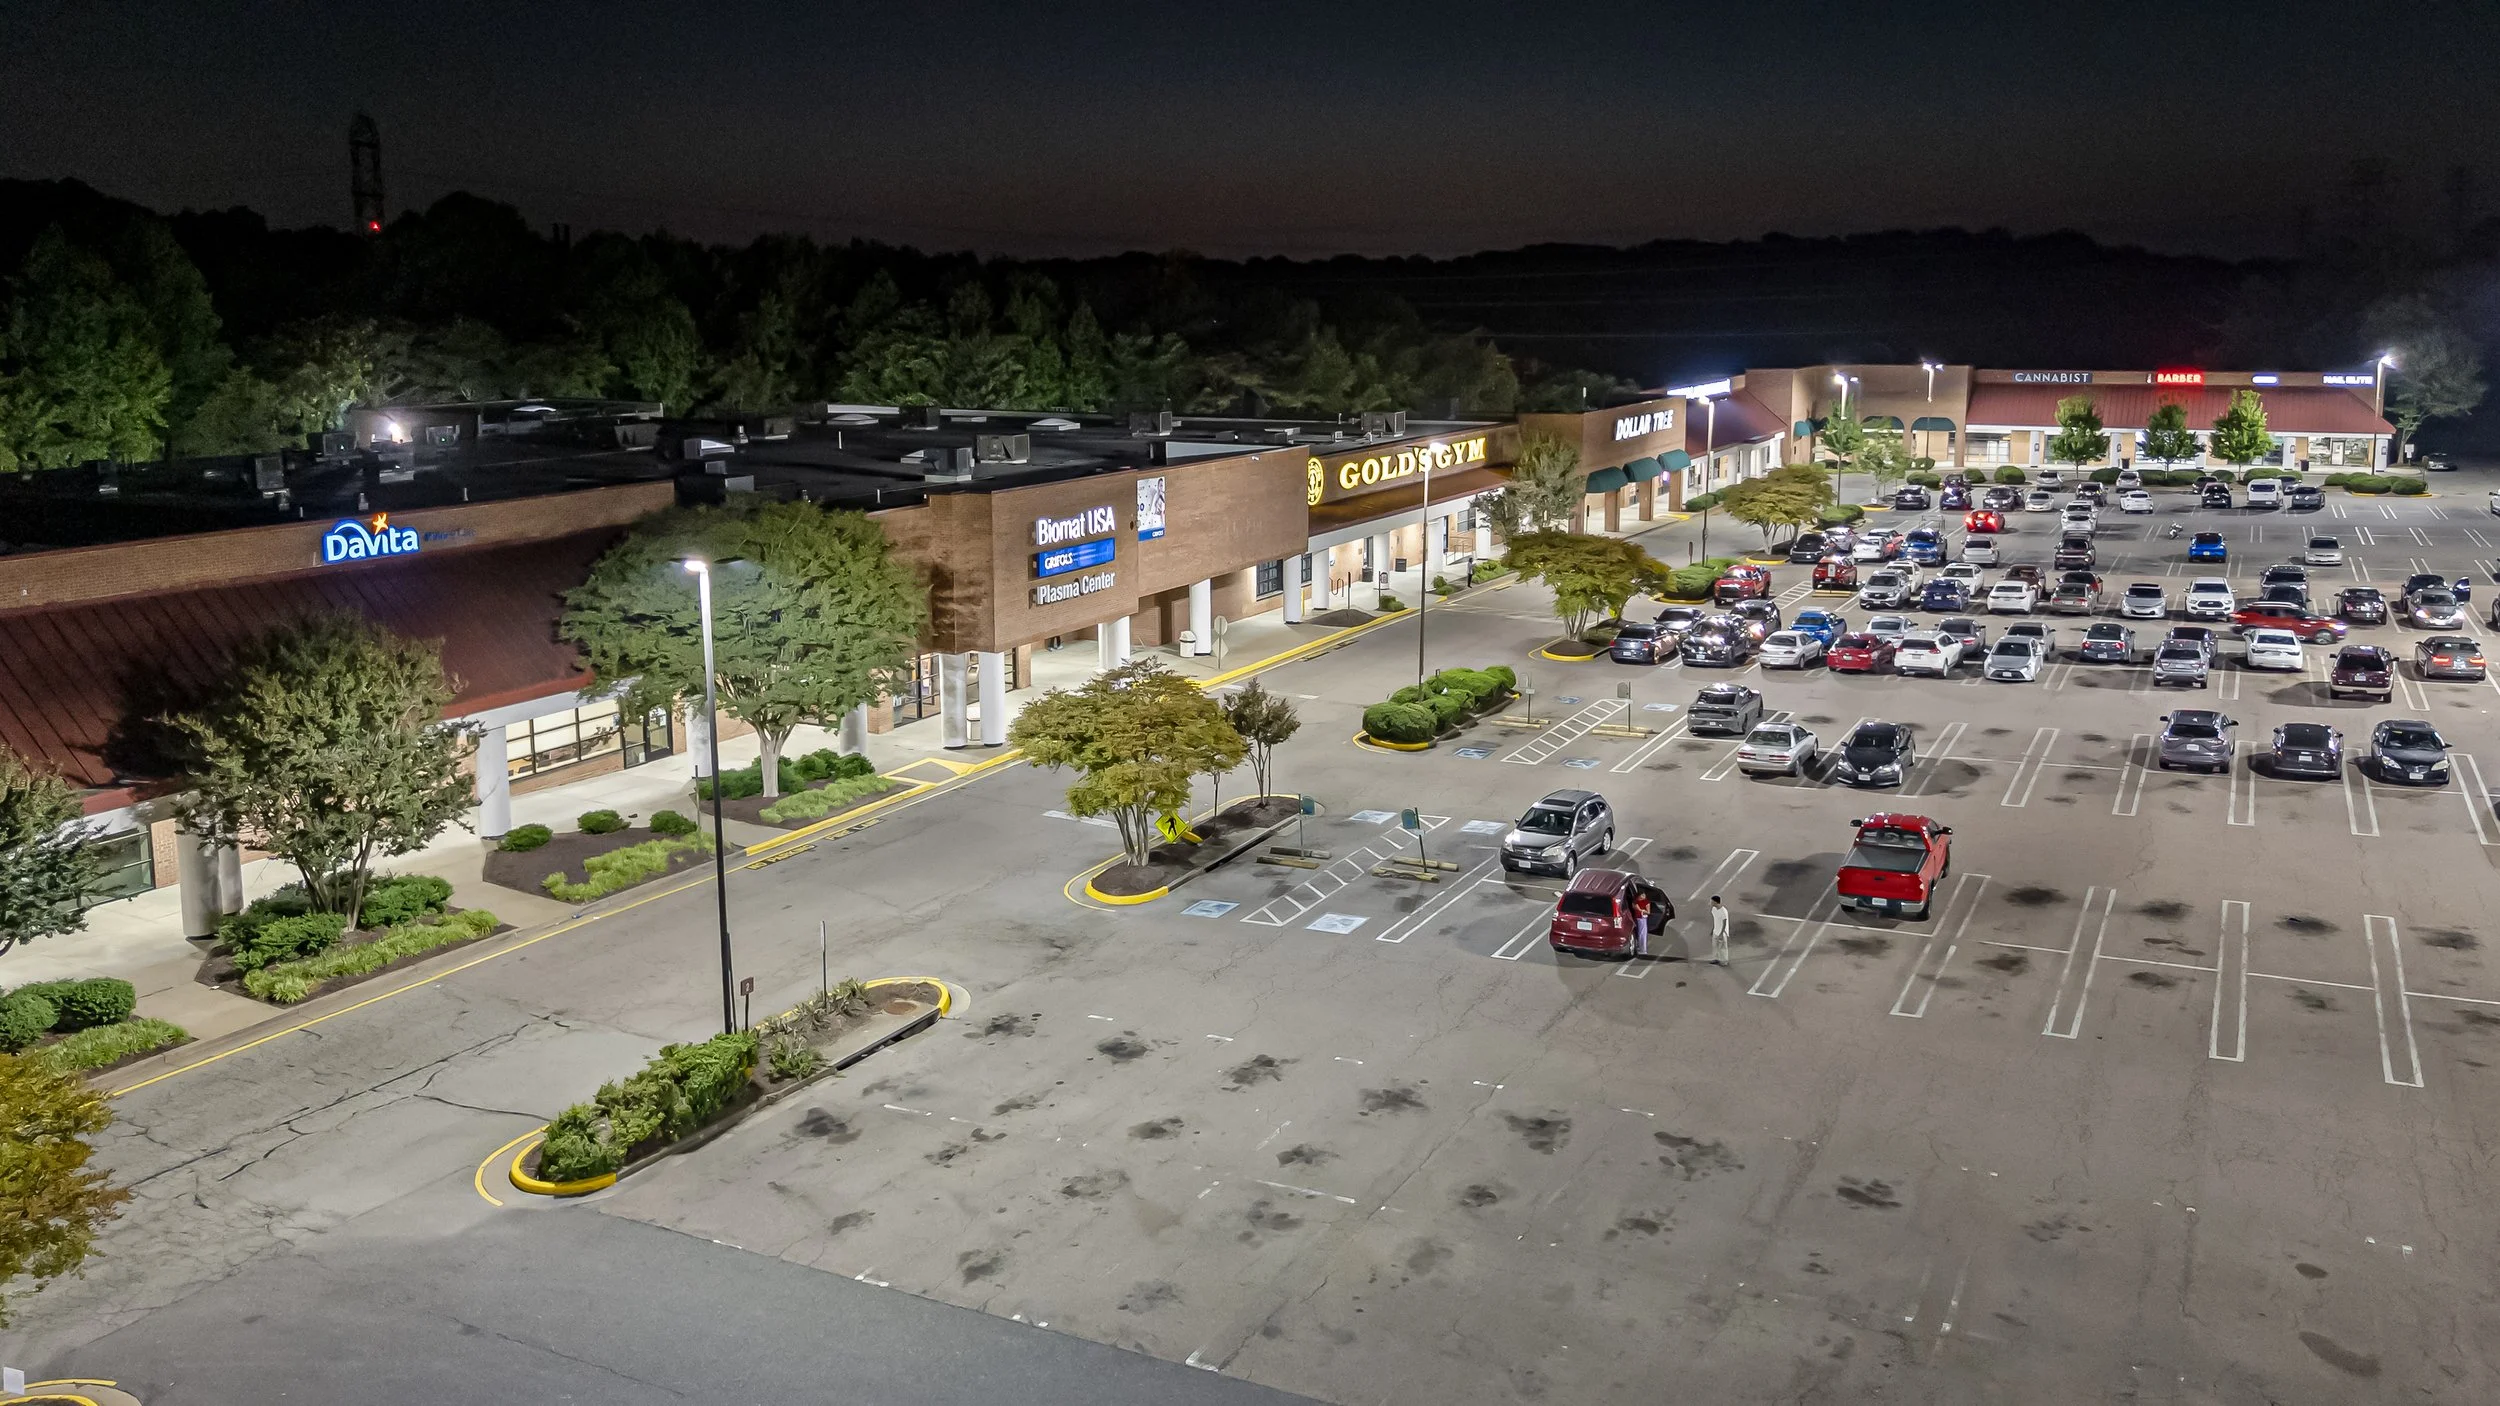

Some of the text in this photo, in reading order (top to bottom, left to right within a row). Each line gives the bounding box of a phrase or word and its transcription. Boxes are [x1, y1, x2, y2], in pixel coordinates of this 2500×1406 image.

[2014, 372, 2089, 383] CANNABIST
[2157, 373, 2202, 383] BARBER
[1615, 409, 1674, 441] DOLLAR TREE
[1338, 447, 1432, 490] GOLD'S
[1435, 437, 1487, 469] GYM
[325, 523, 419, 562] DaVita
[1036, 506, 1116, 546] Biomat USA
[1037, 572, 1116, 605] Plasma Center
